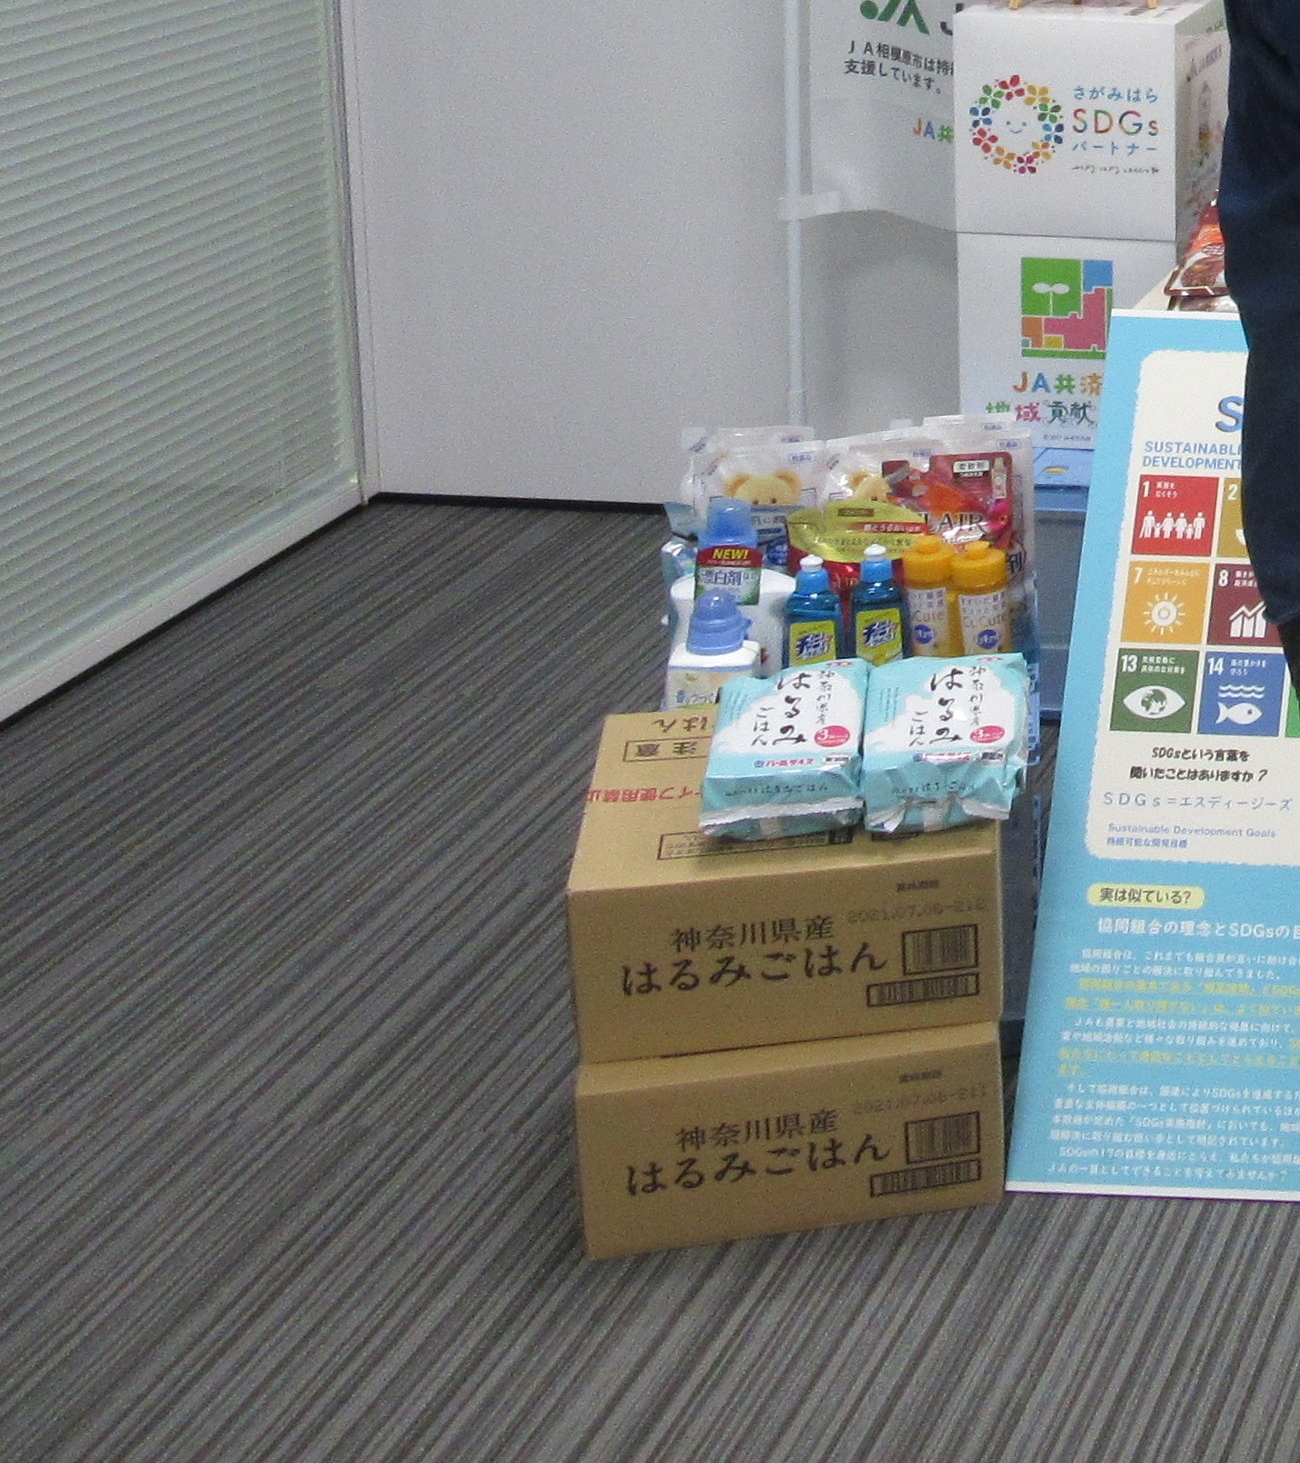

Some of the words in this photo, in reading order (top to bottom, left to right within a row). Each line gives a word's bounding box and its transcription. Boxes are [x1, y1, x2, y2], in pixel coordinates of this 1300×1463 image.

[1073, 85, 1159, 104] さがみはら
[1072, 108, 1159, 137] SDGs
[1072, 141, 1158, 157] パートナー
[1142, 481, 1150, 497] 1
[1228, 485, 1237, 500] 2
[712, 549, 749, 559] NEW!
[1135, 567, 1144, 584] 7
[1219, 570, 1228, 588] 8
[1121, 655, 1137, 673] 13
[1208, 657, 1224, 675] 14
[1152, 747, 1249, 762] SDGsという言葉を
[1108, 823, 1170, 834] Sustainable
[1173, 825, 1243, 837] Development
[1246, 828, 1276, 838] Goals
[670, 914, 834, 951] 神奈川県産
[620, 942, 888, 996] はるみごはん
[675, 1109, 839, 1151] 神奈川県産
[627, 1135, 891, 1196] はるみごはん
